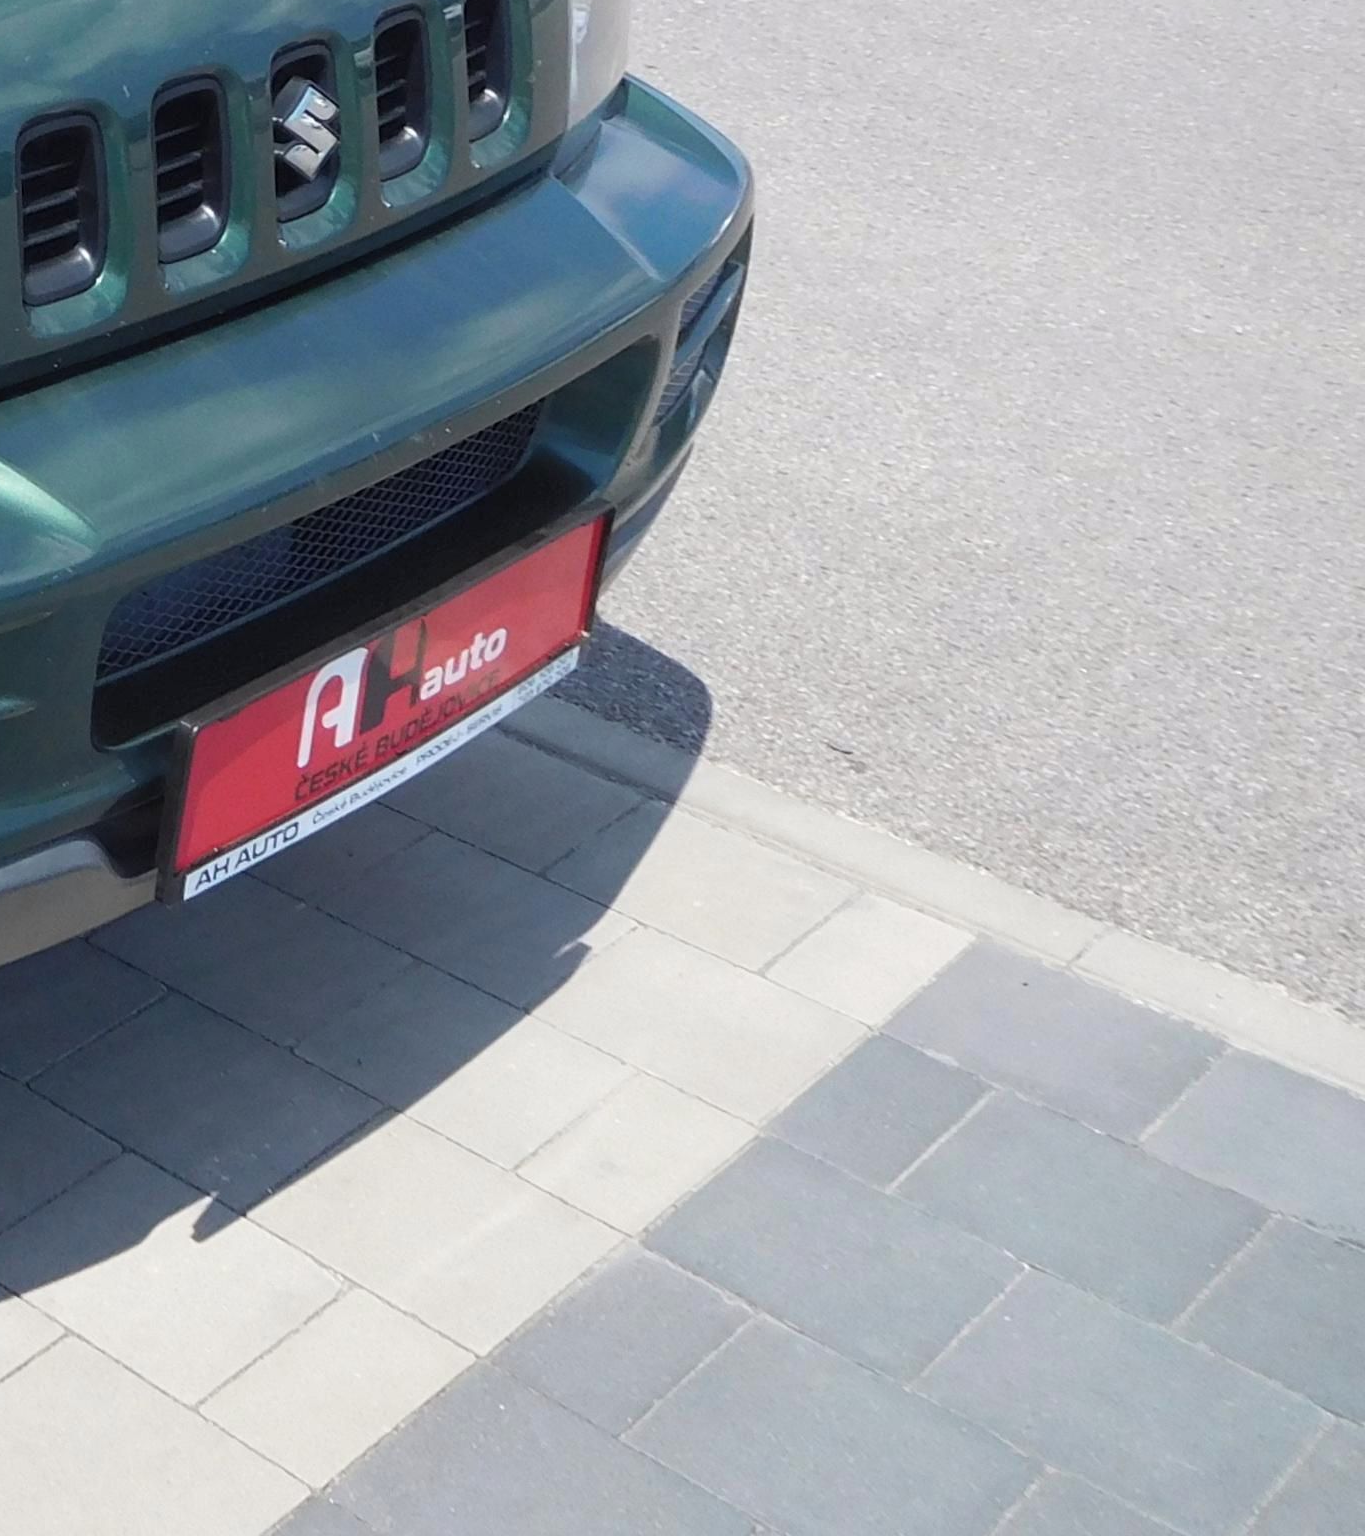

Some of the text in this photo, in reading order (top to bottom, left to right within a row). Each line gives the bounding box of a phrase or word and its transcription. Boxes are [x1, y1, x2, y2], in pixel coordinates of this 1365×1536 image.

[420, 627, 507, 701] auto
[295, 741, 367, 801] ČESKÉ
[195, 857, 230, 890] AH
[235, 822, 299, 869] AUTO
